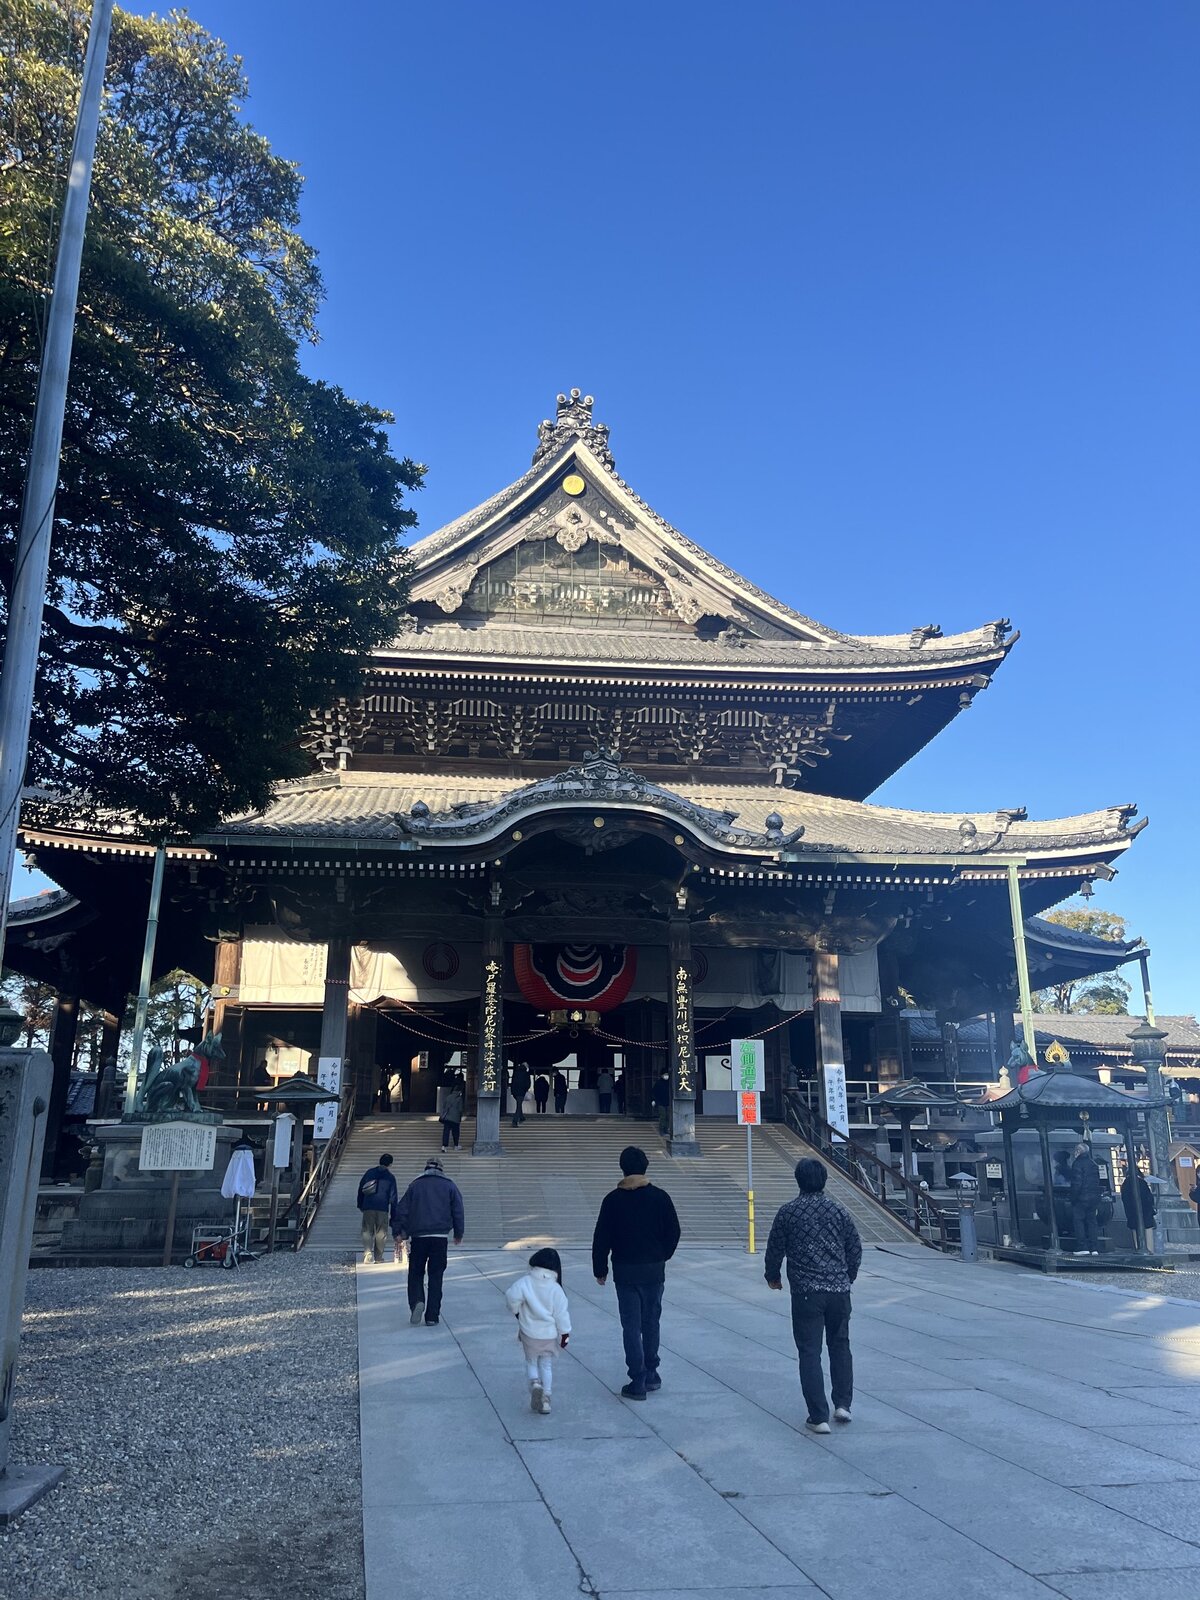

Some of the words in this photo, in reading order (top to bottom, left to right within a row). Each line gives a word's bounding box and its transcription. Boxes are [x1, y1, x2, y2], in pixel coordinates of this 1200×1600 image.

[741, 1041, 757, 1090] 左側通行
[741, 1091, 757, 1124] 禁煙
